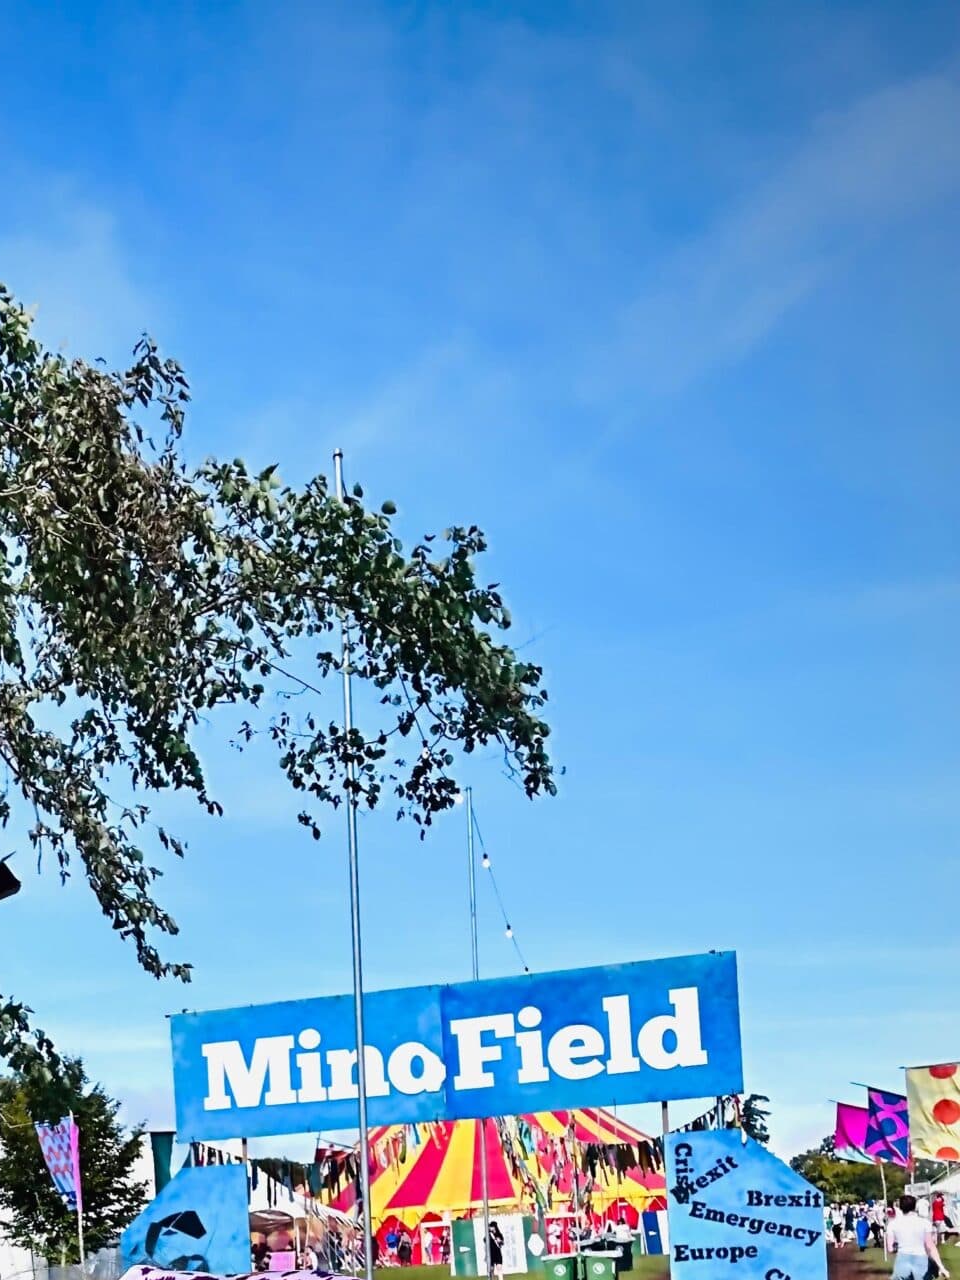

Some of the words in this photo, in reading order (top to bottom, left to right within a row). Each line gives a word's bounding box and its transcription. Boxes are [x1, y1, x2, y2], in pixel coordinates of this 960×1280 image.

[449, 986, 709, 1092] Field
[746, 1189, 822, 1208] Brexit
[688, 1200, 822, 1247] Emergency
[673, 1244, 758, 1264] Europe
